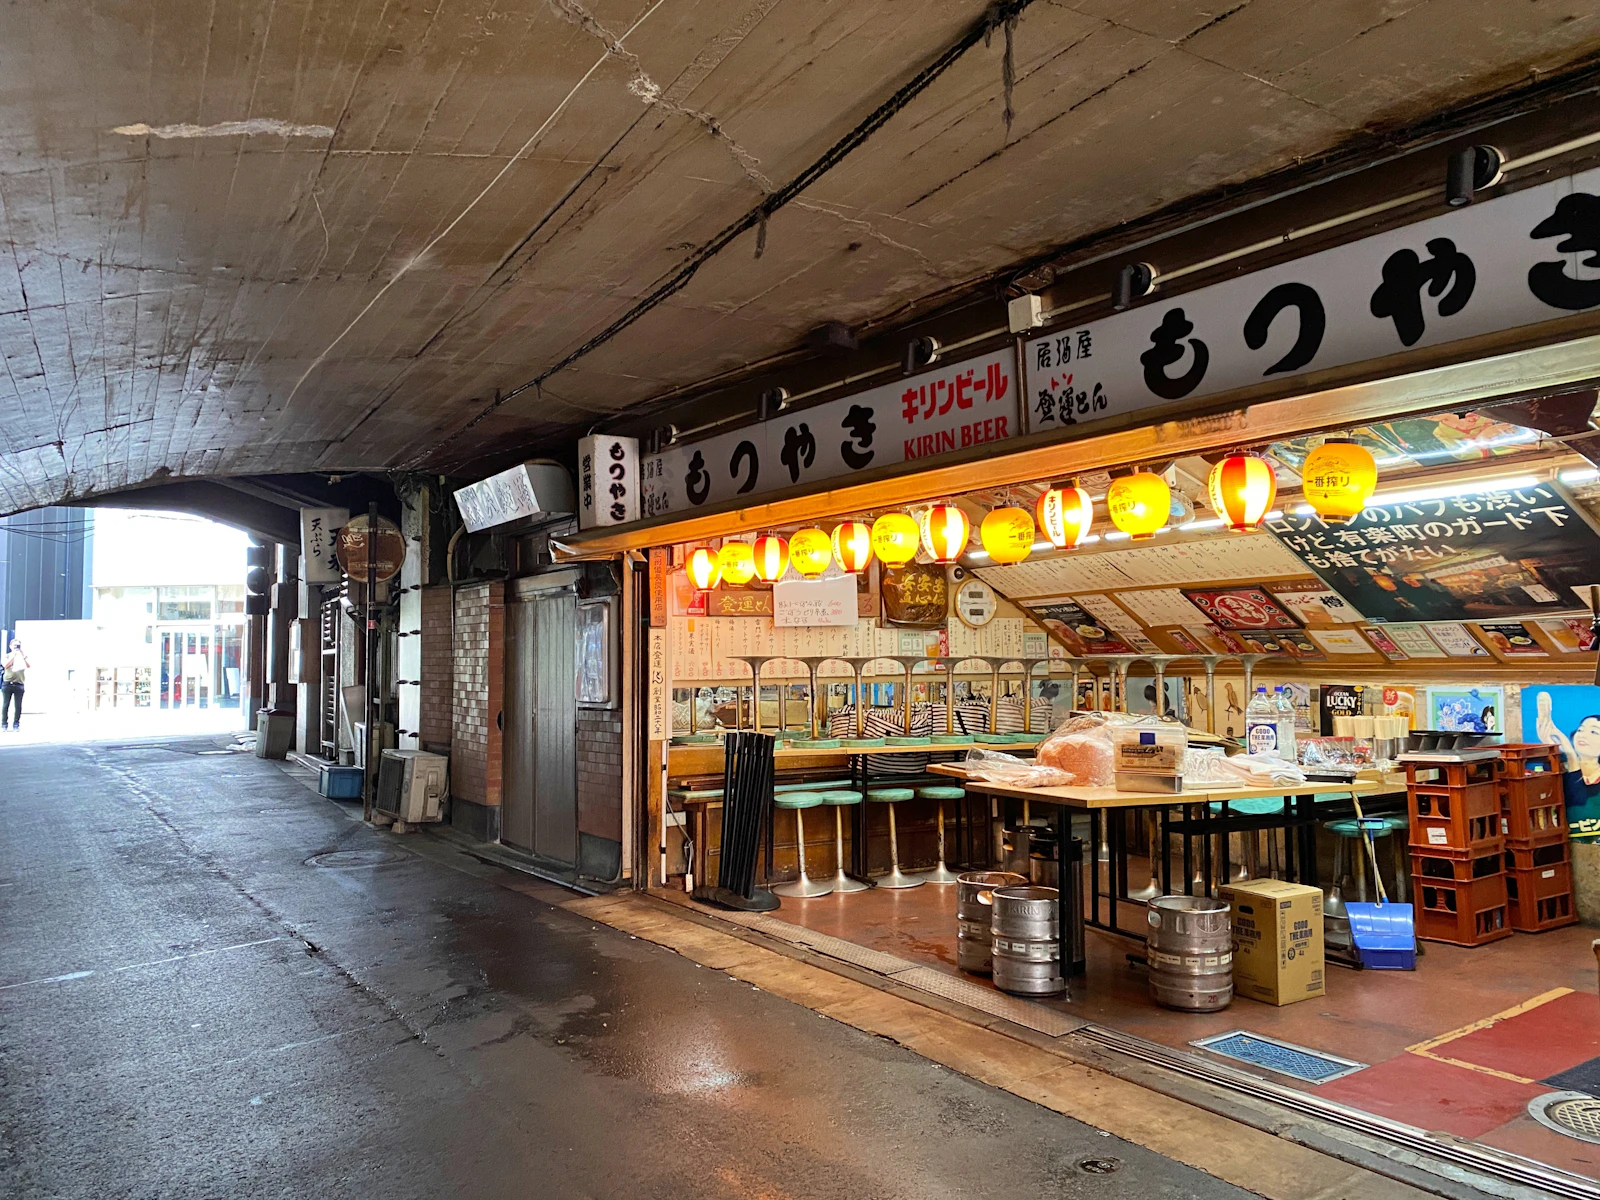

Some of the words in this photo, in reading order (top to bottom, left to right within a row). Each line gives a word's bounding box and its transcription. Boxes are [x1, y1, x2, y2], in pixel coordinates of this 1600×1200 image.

[1036, 329, 1093, 372] 居酒屋
[901, 362, 1009, 424] キリンビール
[1034, 382, 1108, 425] 登運とん
[684, 404, 877, 506] もつやき
[903, 427, 957, 461] KIRIN
[960, 415, 1010, 449] BEER
[582, 454, 592, 510] 営業中
[609, 442, 627, 521] もつやき
[1306, 475, 1351, 488] 一番搾り
[310, 517, 323, 558] 天ぷら
[1048, 496, 1061, 537] キリンビール
[1282, 505, 1569, 552] けど、有楽町のガード下
[1304, 544, 1470, 569] も捨てがたい。
[1326, 695, 1358, 709] LUCKY
[1385, 689, 1396, 701] 新
[1008, 903, 1040, 915] KIRIN
